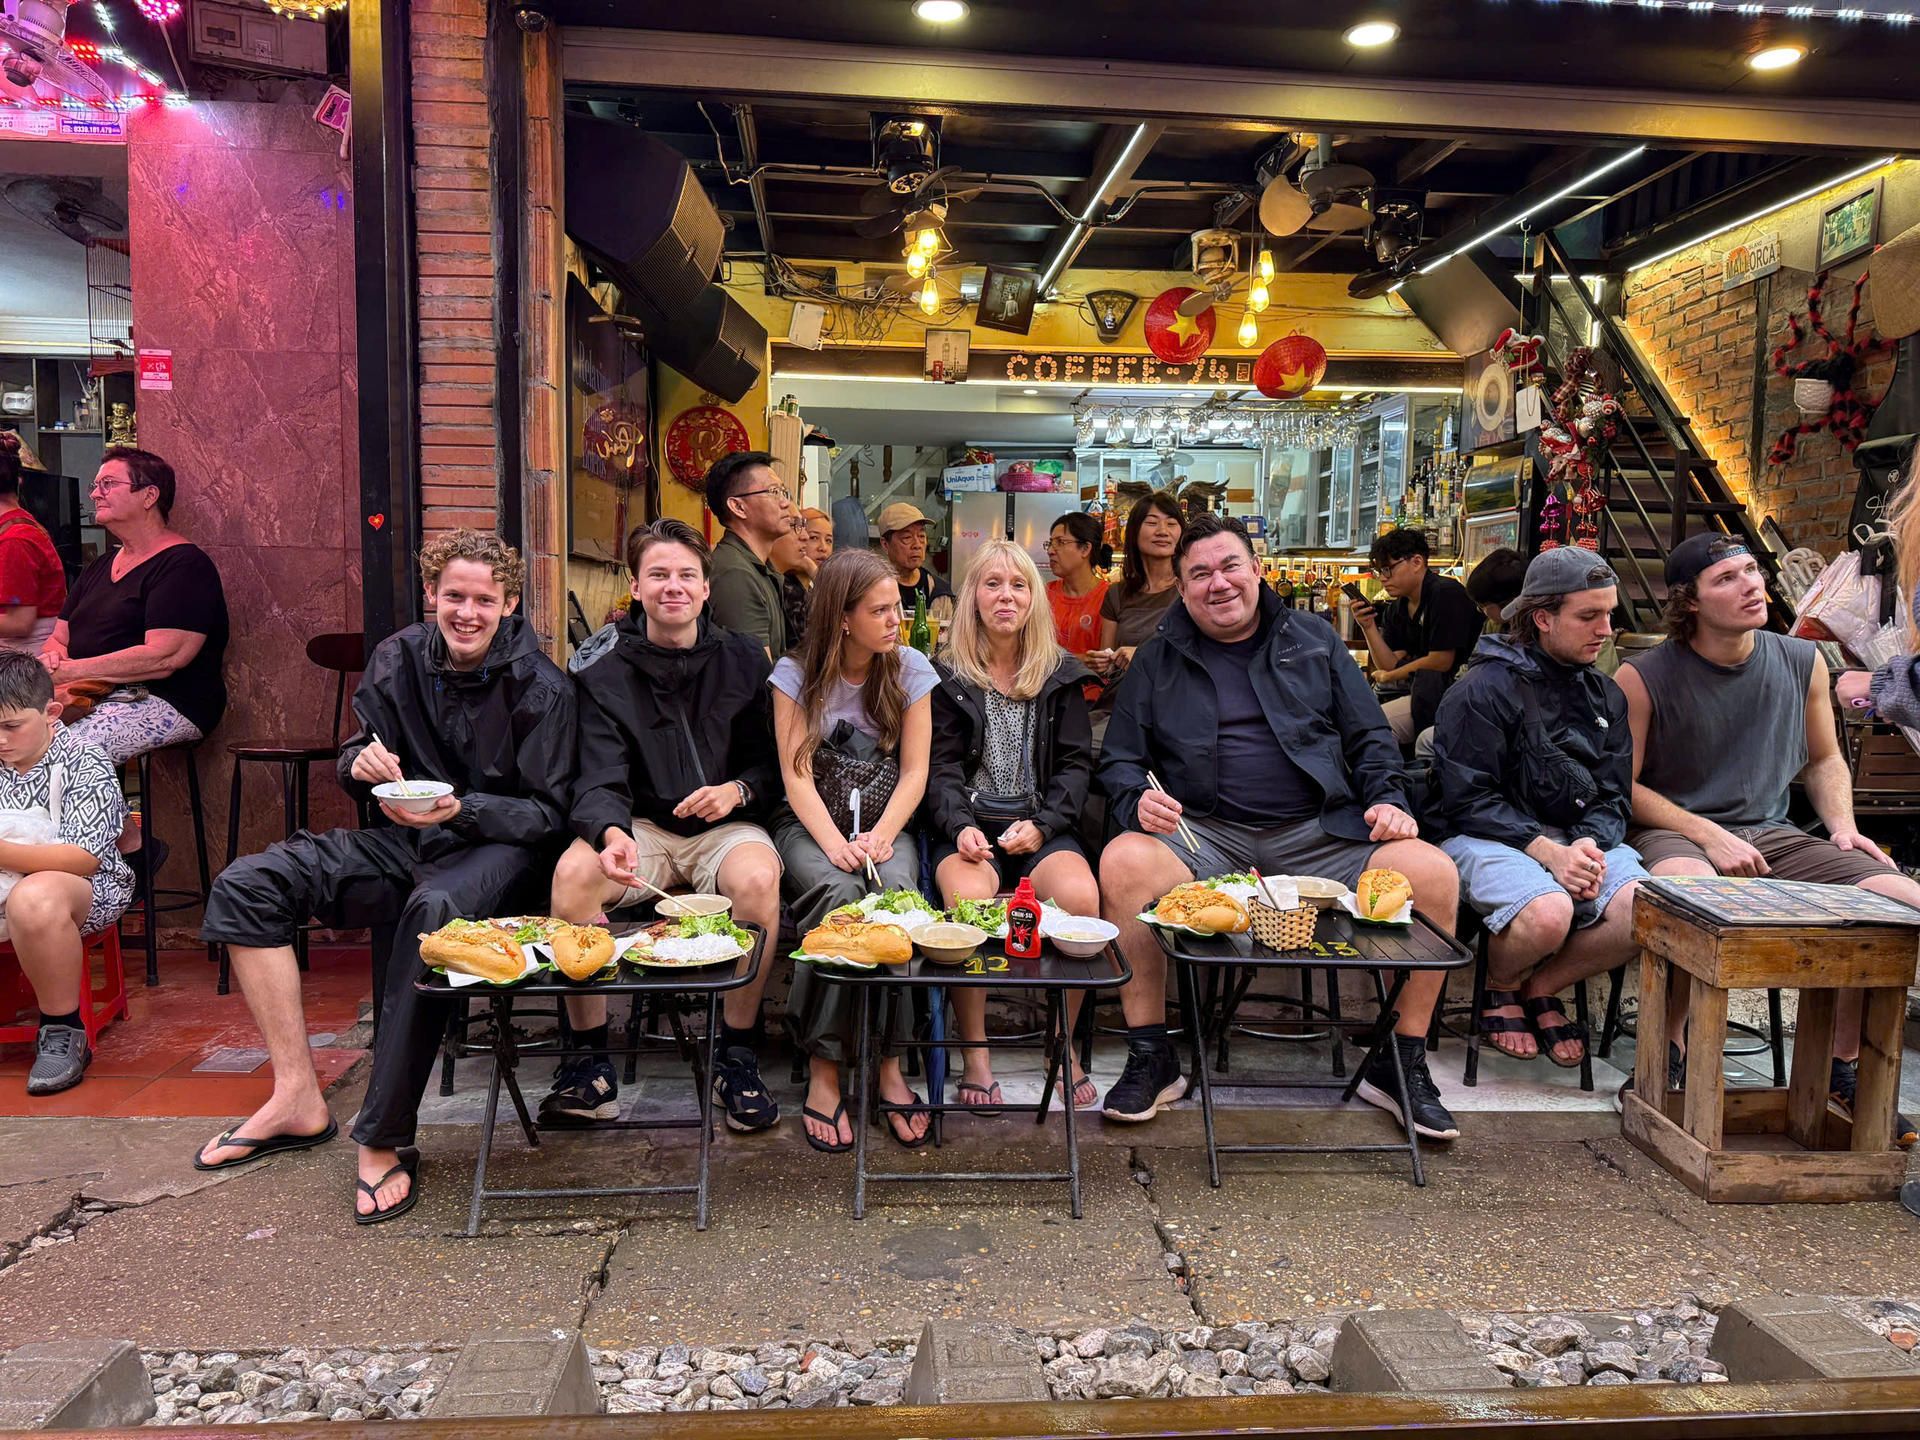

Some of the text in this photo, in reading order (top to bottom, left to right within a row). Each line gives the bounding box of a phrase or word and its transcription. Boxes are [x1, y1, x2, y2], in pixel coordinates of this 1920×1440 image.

[1726, 243, 1776, 280] MALLORCA
[946, 475, 975, 484] UniAqua
[1011, 910, 1034, 919] CHIN-SU
[965, 955, 1011, 975] 12
